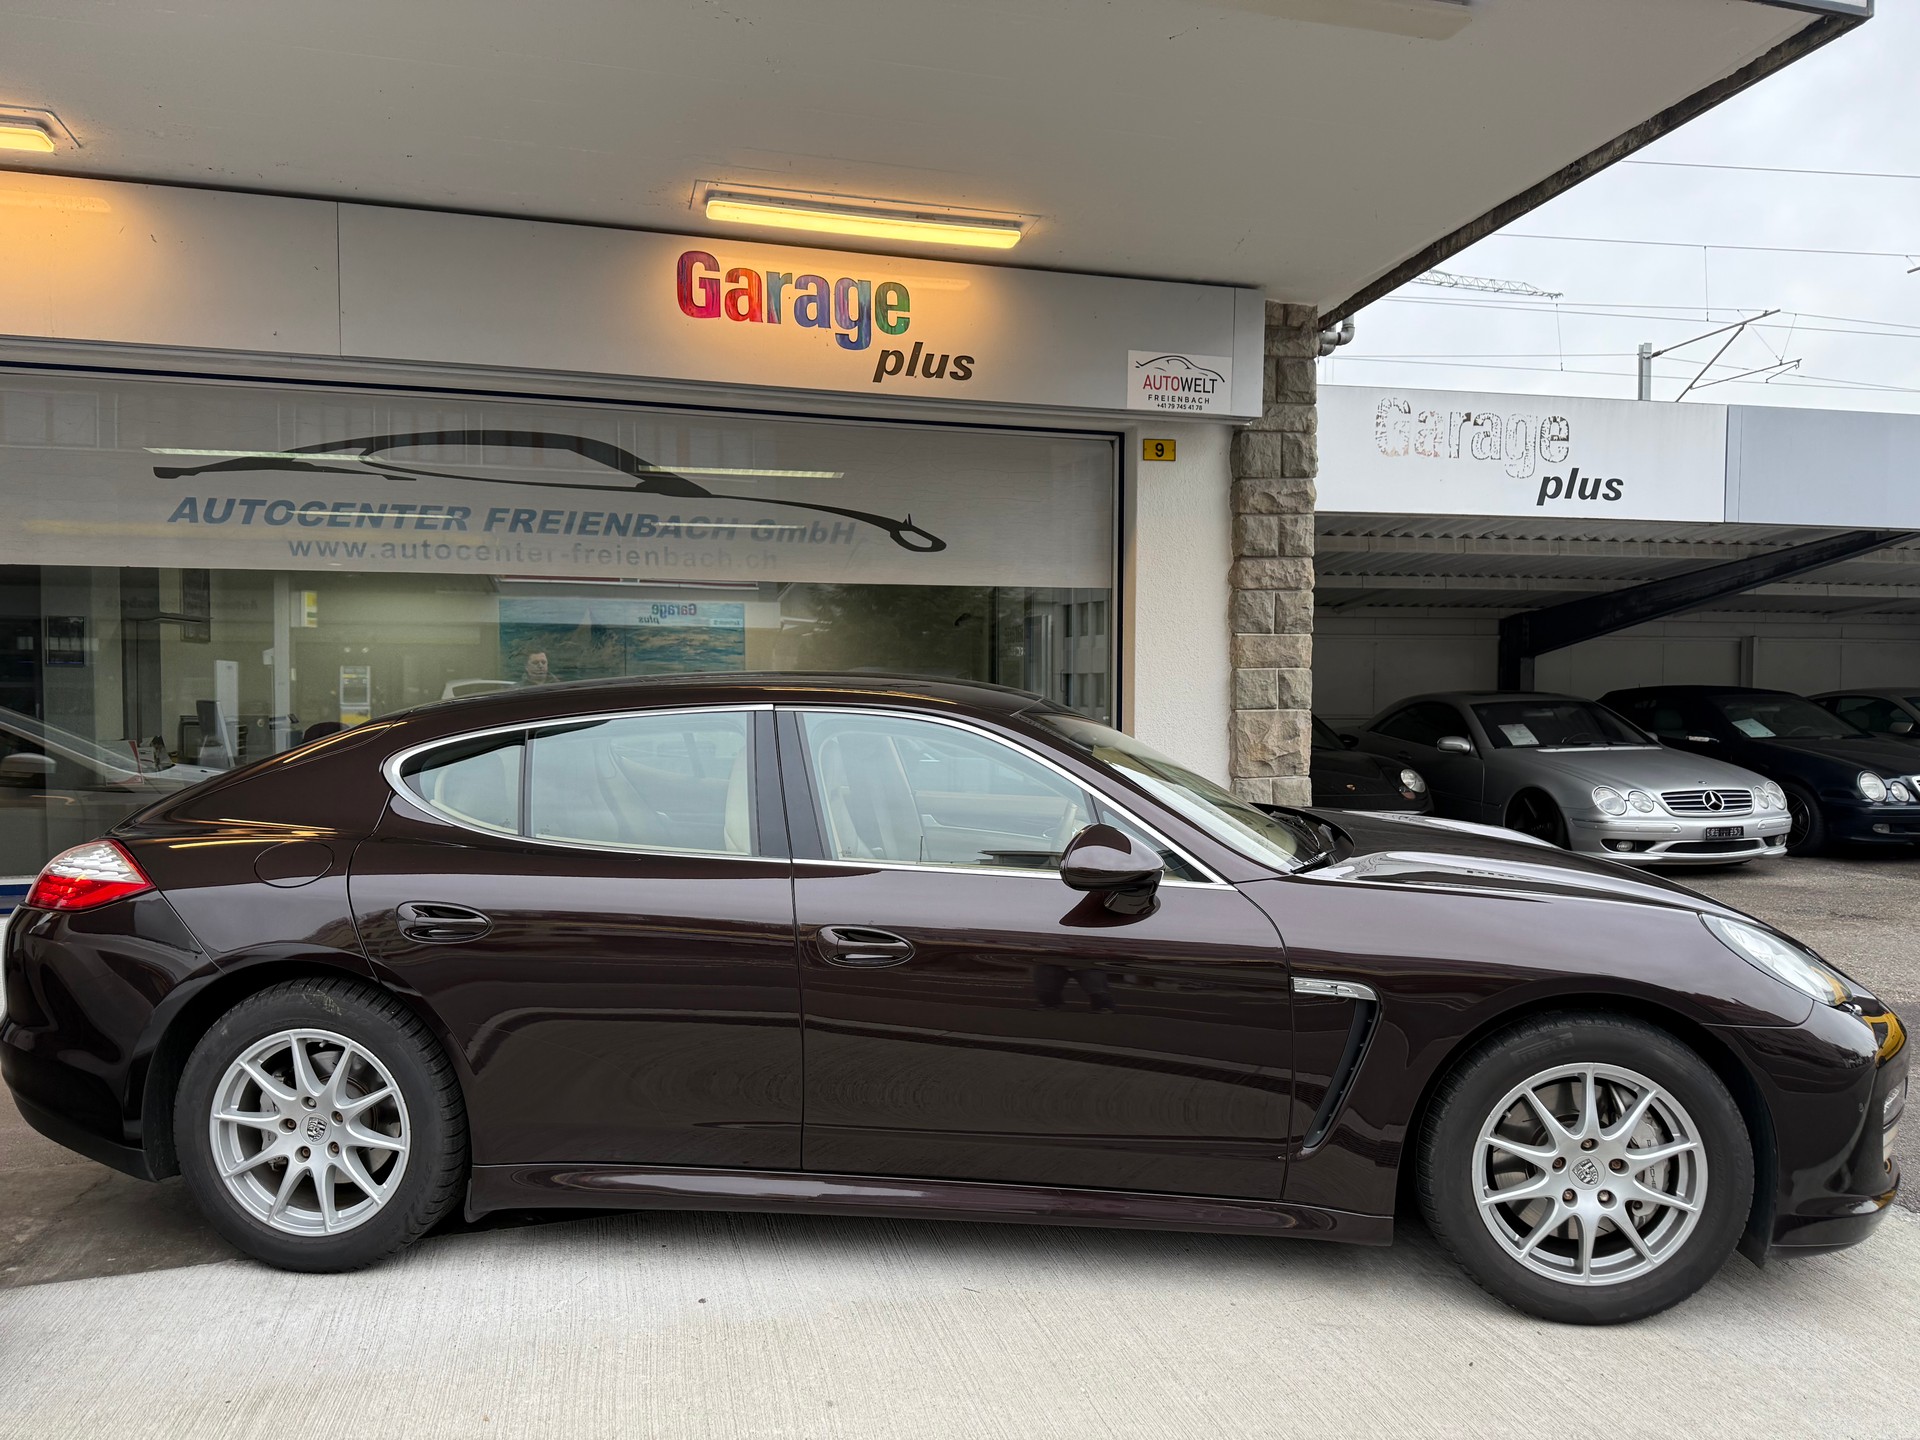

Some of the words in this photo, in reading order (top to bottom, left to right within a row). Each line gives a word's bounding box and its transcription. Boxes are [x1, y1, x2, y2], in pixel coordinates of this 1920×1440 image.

[677, 250, 911, 350] Garage
[872, 341, 975, 383] plus
[1142, 374, 1218, 394] AUTOWELT
[1148, 394, 1210, 405] FREIENBACH
[1155, 442, 1165, 458] 9
[1375, 396, 1570, 479] Garage
[1536, 467, 1624, 506] plus
[167, 496, 472, 532] AUTOCENTER
[482, 507, 739, 542] FREIENBACH
[749, 518, 857, 545] GmbH
[288, 538, 778, 570] www.autocenter-freienbach.ch
